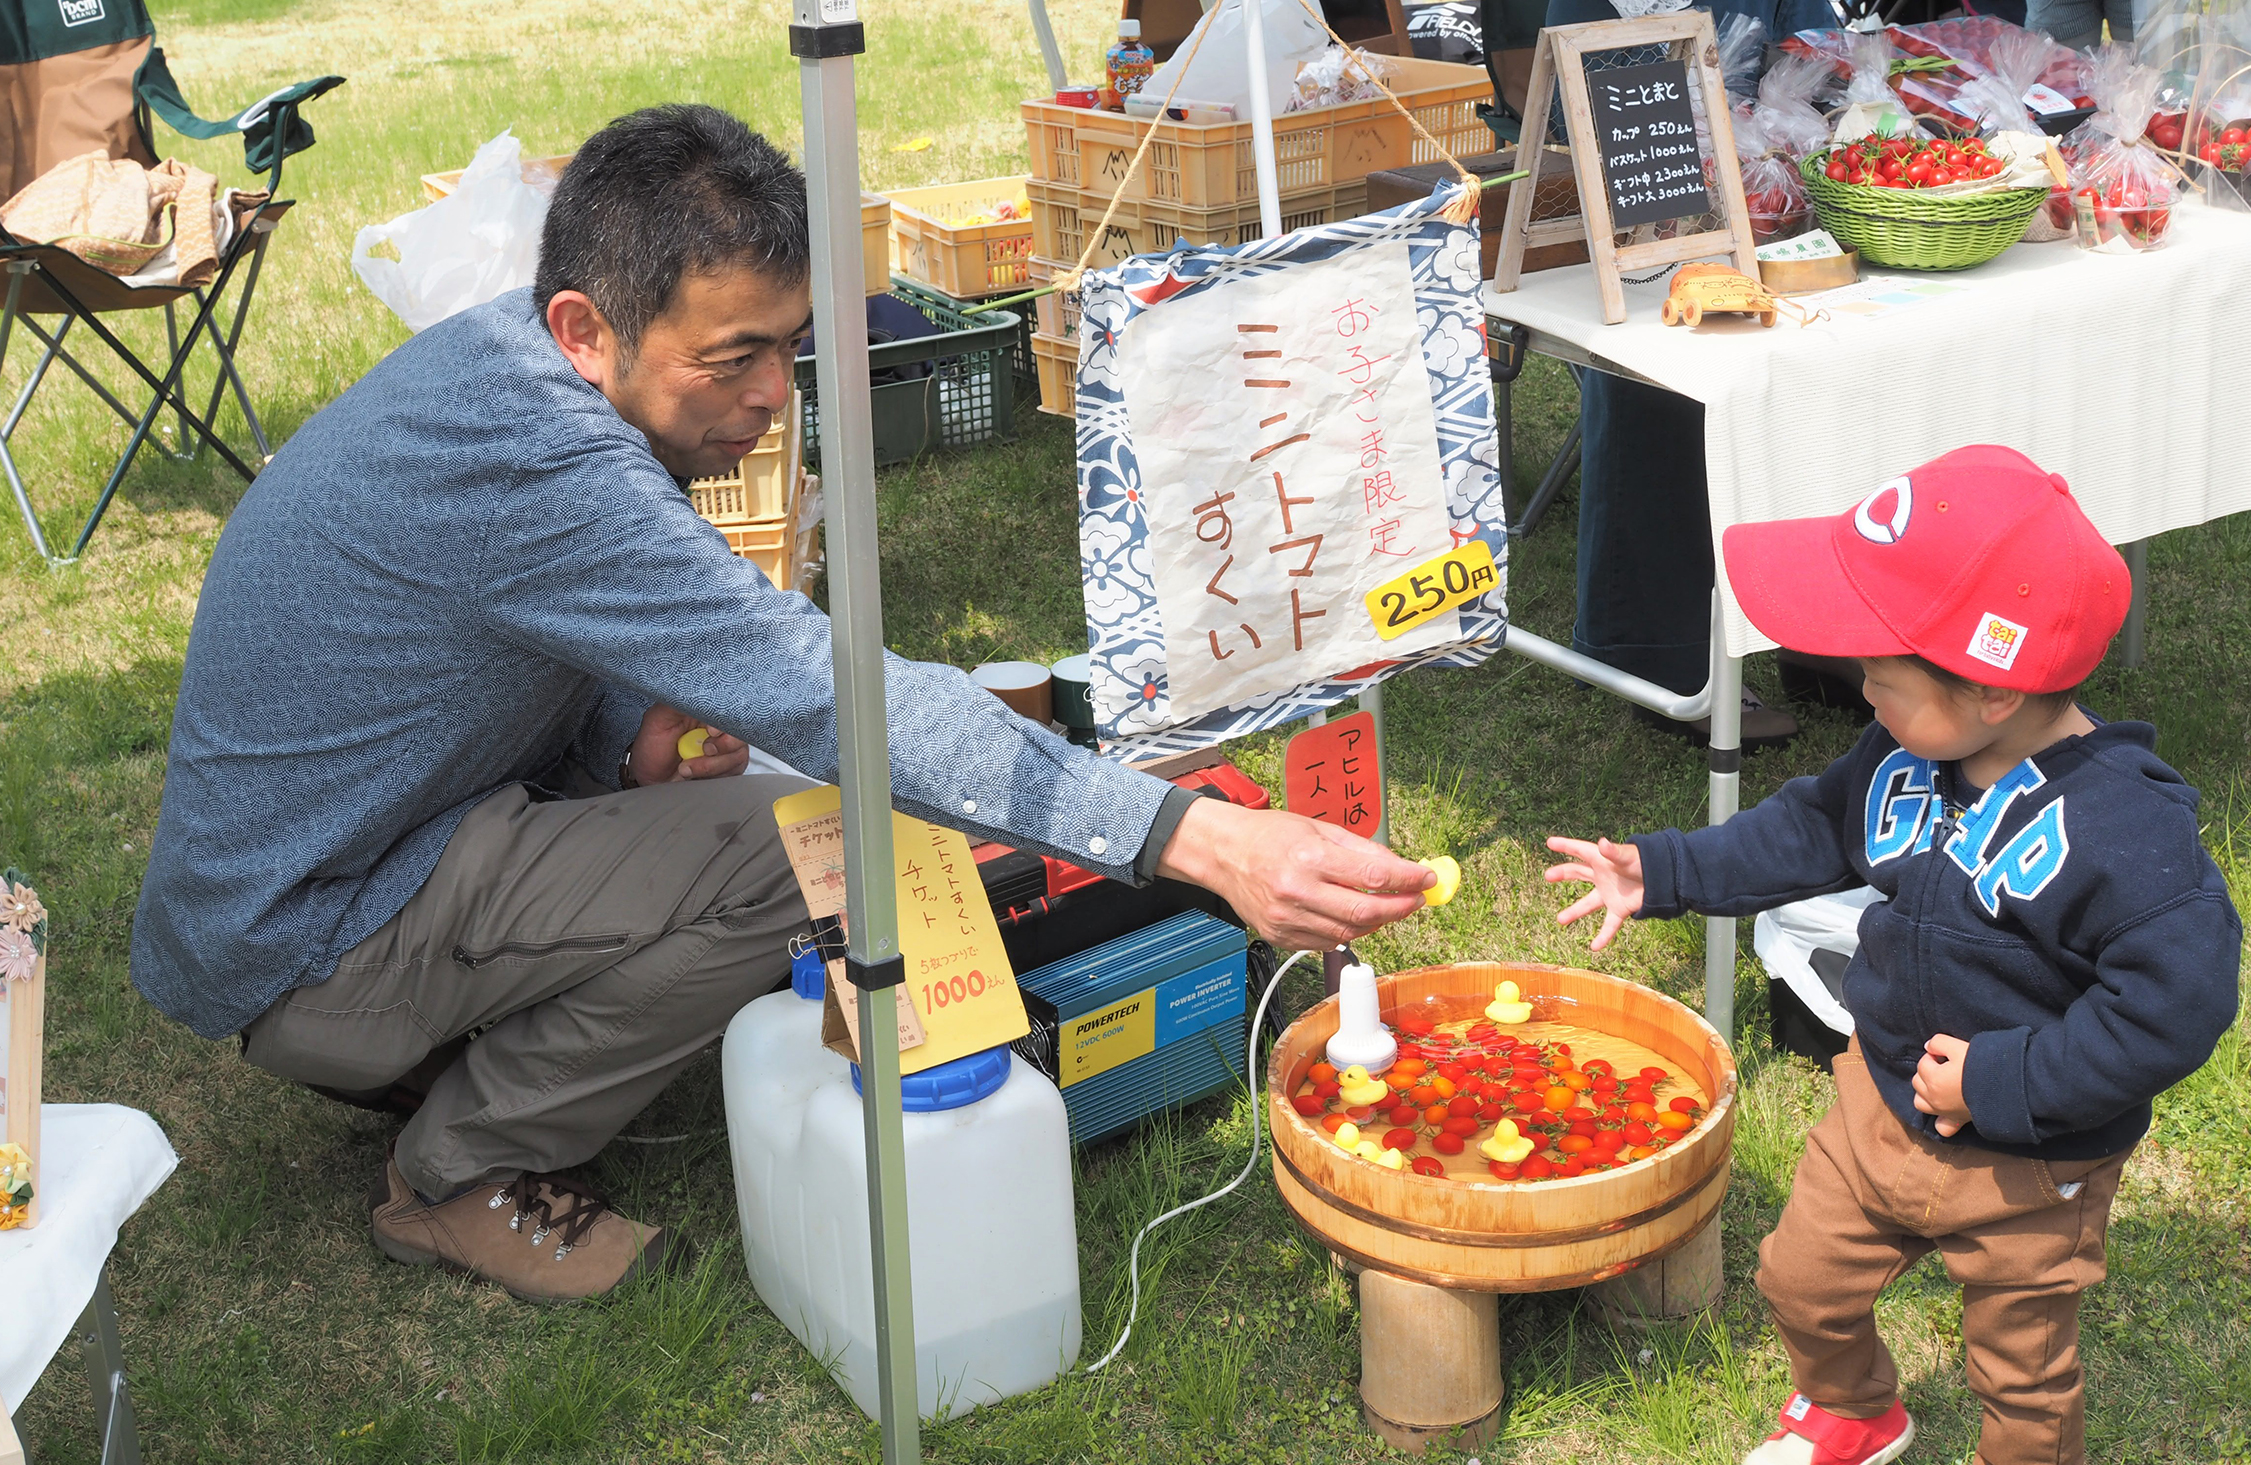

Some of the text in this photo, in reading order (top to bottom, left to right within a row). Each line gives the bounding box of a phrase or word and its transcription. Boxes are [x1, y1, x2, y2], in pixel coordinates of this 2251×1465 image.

[71, 9, 97, 20] BRAND
[1440, 29, 1451, 41] by
[1607, 81, 1679, 111] ミニとまと
[1612, 121, 1692, 142] カップ 250えん
[1609, 144, 1695, 168] バスケット 1000えん
[1613, 164, 1700, 191] ギフト中 2300えん
[1617, 183, 1705, 208] ギフト大 3000えん
[1331, 298, 1416, 557] お子さま限定
[1237, 324, 1326, 651] ミニトマト
[1853, 476, 1913, 545] C
[1192, 490, 1262, 661] すくい
[1380, 560, 1494, 627] 250円
[1988, 620, 2017, 645] tai
[1339, 729, 1368, 826] アヒルは
[800, 827, 843, 848] チケット
[1865, 747, 2069, 918] GAP
[902, 859, 938, 929] チケット
[920, 945, 979, 975] 5枚つづりで
[922, 969, 1005, 1015] 1000えん
[1169, 978, 1231, 1009] POWER INVERTER
[1075, 1002, 1140, 1036] POWERTECH
[1075, 1024, 1125, 1050] 12VDC 600W
